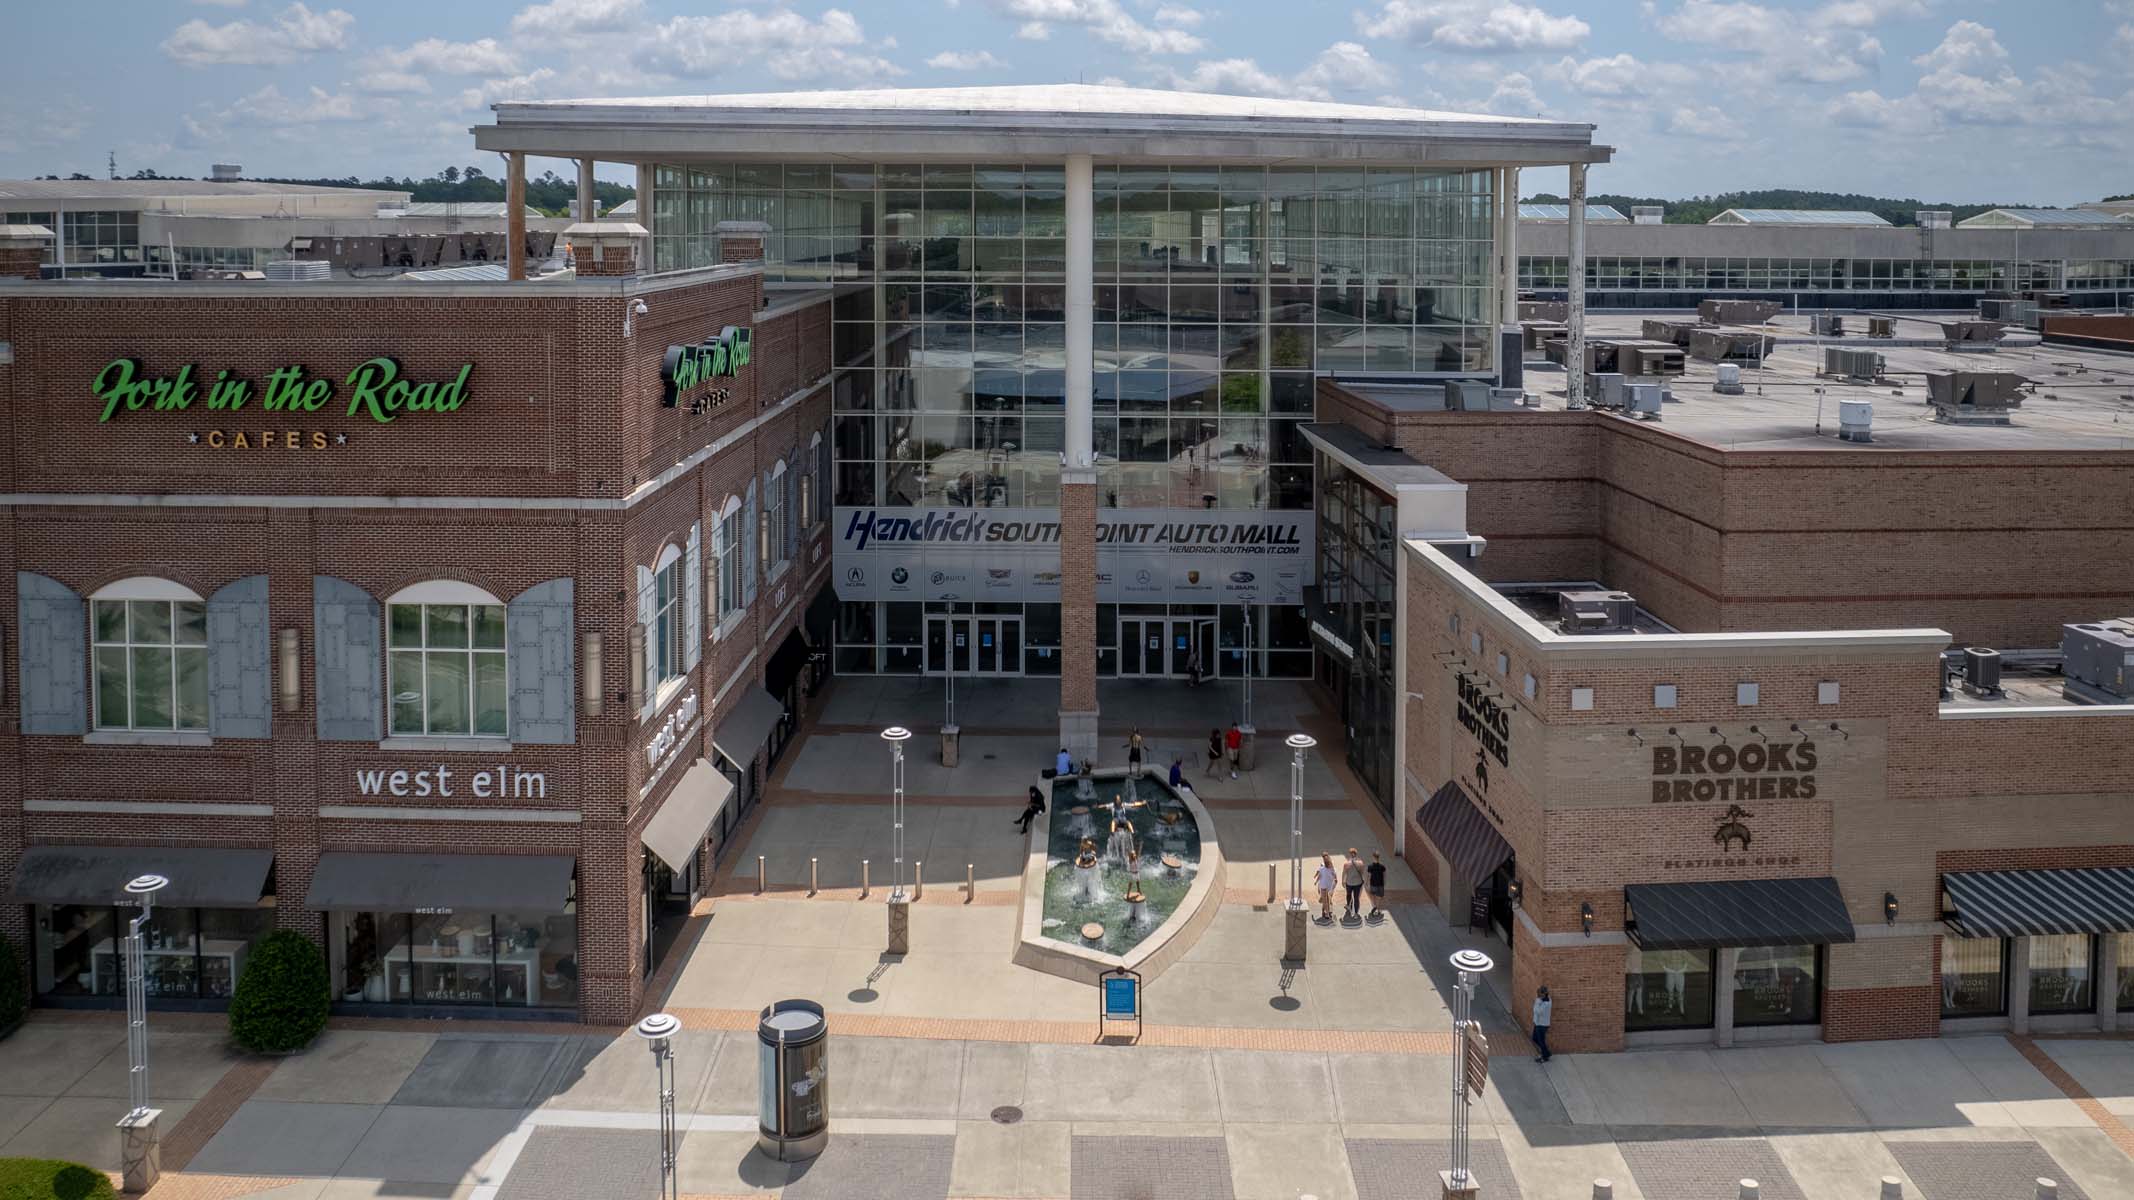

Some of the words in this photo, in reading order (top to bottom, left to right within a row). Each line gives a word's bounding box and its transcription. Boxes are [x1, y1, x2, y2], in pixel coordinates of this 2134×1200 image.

[727, 326, 752, 377] Road
[92, 358, 198, 423] Fork
[207, 370, 252, 410] in
[263, 366, 332, 411] the
[345, 357, 472, 423] Road
[208, 431, 328, 449] CAFES
[845, 511, 986, 550] Hendrick
[985, 522, 1154, 544] SOUTOINT
[1154, 523, 1228, 544] AUTO
[1229, 525, 1300, 545] MALL
[812, 542, 823, 564] LOFT
[775, 584, 787, 608] LOFT
[808, 652, 827, 662] OFT
[1652, 742, 1818, 775] BROOKS
[356, 767, 453, 798] west
[472, 766, 546, 799] elm
[1652, 776, 1817, 804] BROTHERS
[426, 990, 456, 1000] west
[459, 989, 481, 1000] elm
